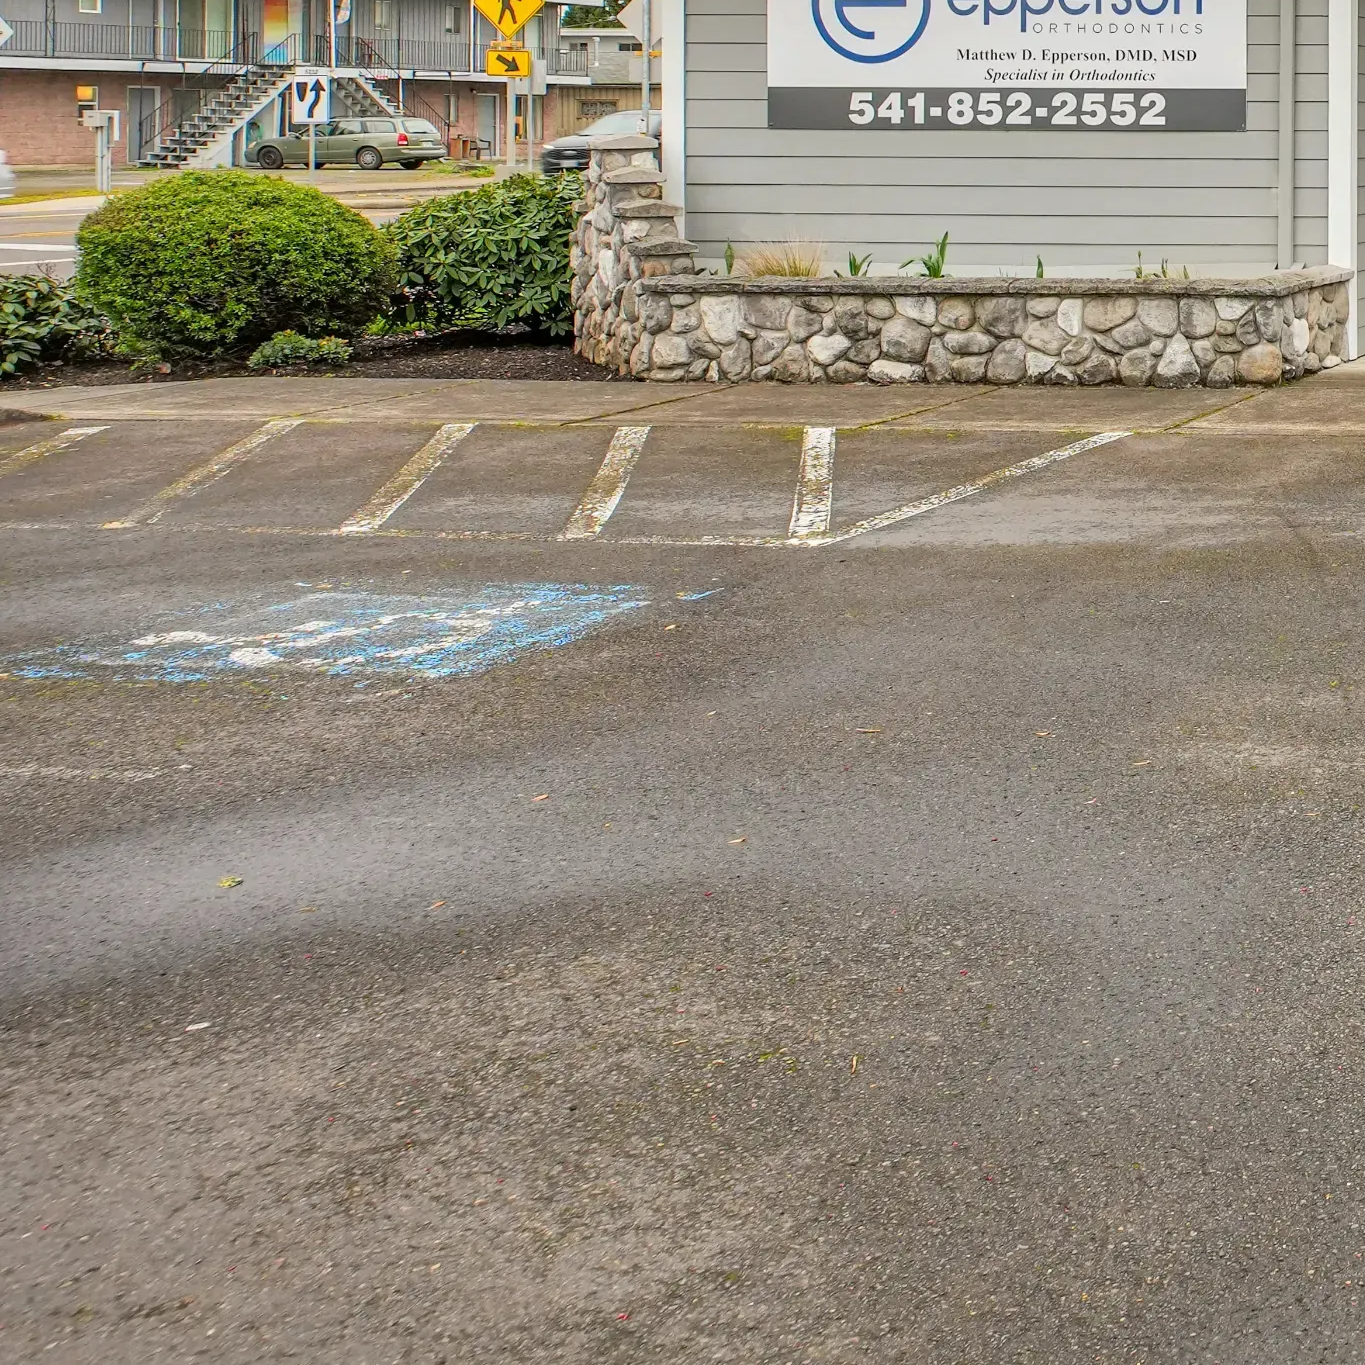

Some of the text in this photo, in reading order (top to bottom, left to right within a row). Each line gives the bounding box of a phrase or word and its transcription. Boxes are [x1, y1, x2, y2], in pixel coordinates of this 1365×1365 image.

[1032, 22, 1203, 35] ORTHODONTICS
[956, 48, 1198, 65] Matthew D. Epperson, DMD, MSD
[984, 68, 1156, 82] Specialist in Orthodontics
[848, 91, 1167, 126] 541-852-2552
